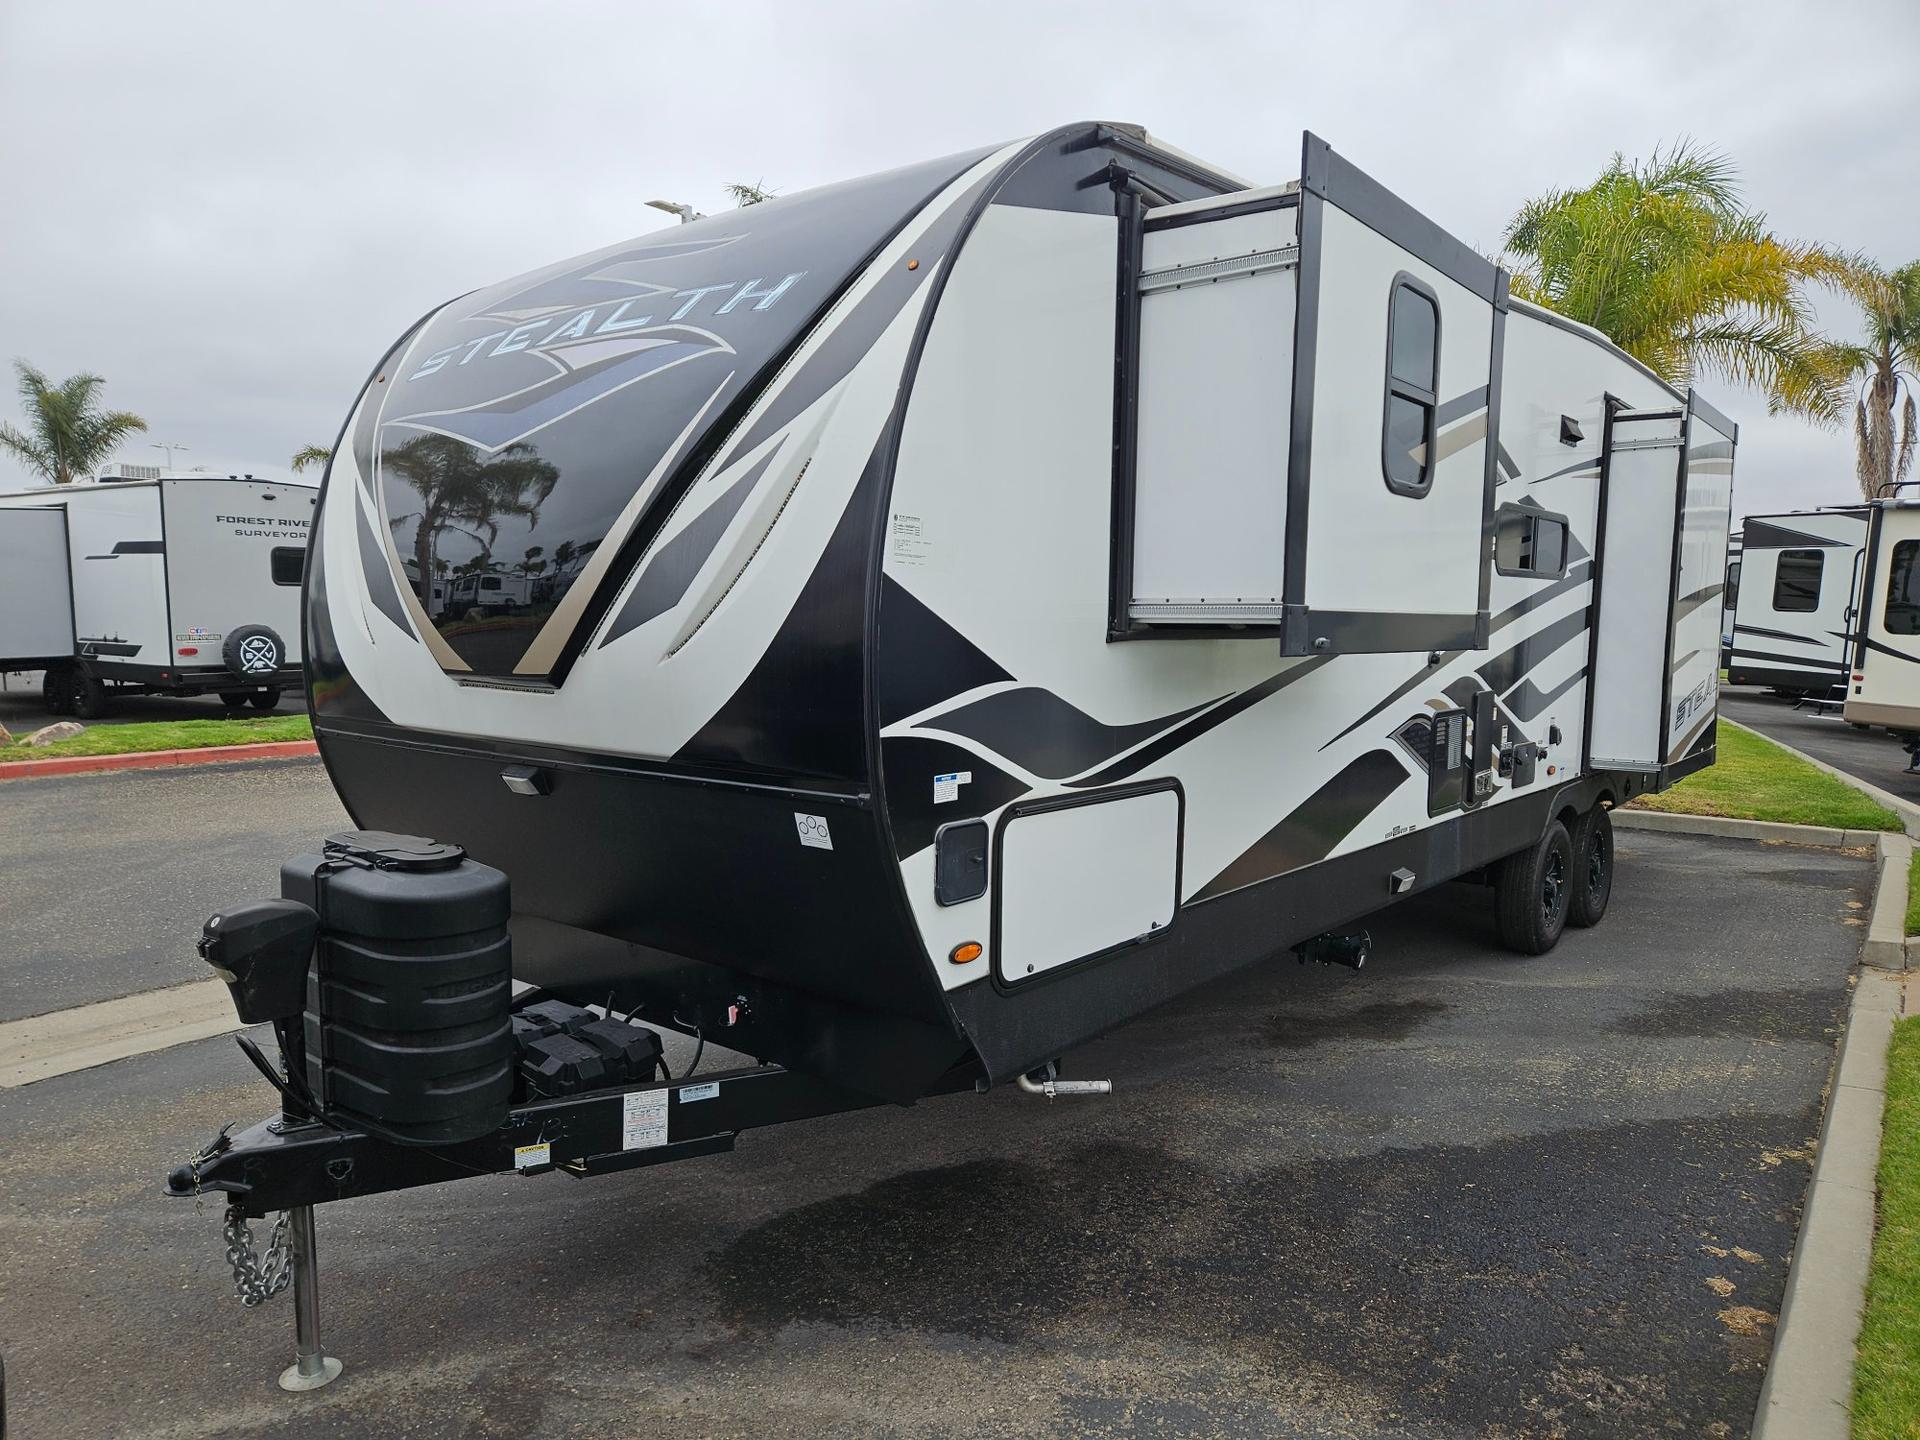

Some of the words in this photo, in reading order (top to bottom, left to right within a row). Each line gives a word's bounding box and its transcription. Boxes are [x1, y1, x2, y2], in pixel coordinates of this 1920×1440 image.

[408, 271, 808, 381] STEALTH
[216, 515, 275, 525] FOREST
[279, 519, 312, 528] RIVE
[235, 529, 307, 539] SURVEYOR
